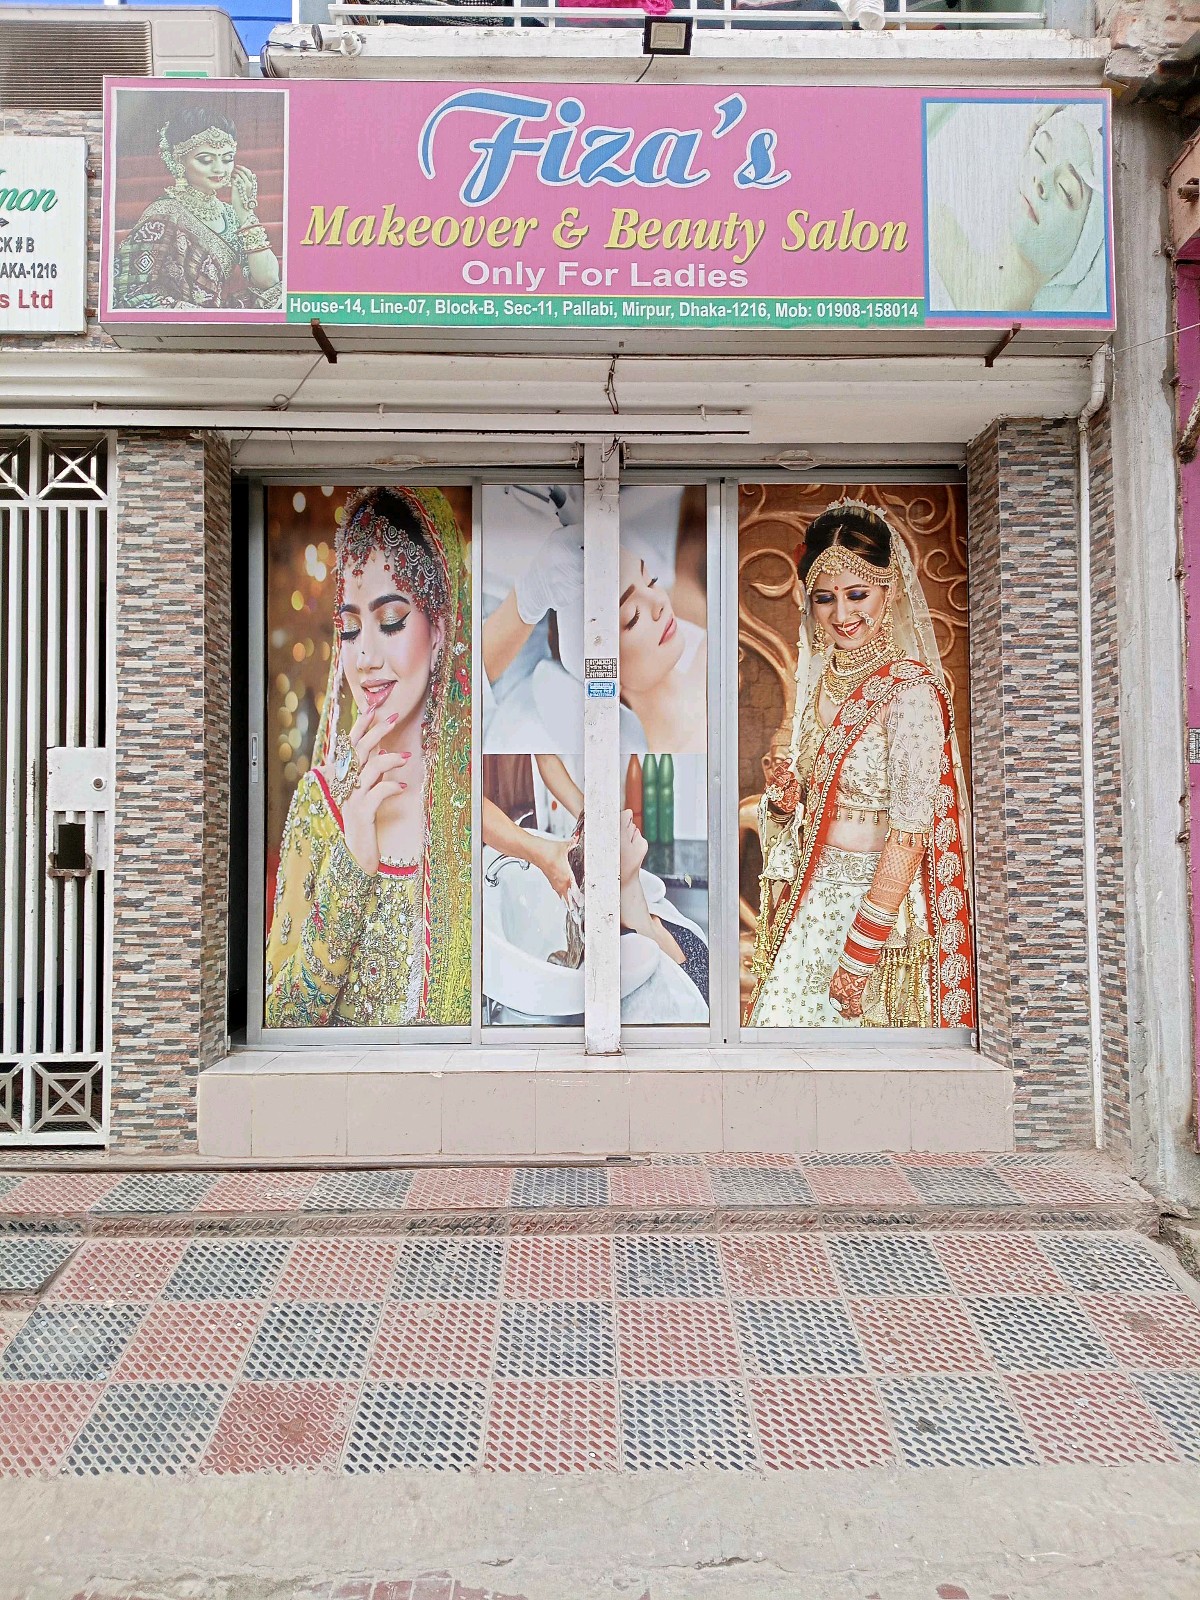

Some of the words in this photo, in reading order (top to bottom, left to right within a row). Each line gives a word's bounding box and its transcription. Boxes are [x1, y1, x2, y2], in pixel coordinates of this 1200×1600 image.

[418, 88, 792, 207] Fiza's
[0, 169, 58, 212] mon
[15, 236, 23, 253] #
[26, 236, 35, 253] B
[300, 203, 539, 248] Makeover
[552, 207, 590, 249] &
[603, 207, 767, 264] Beauty
[780, 208, 909, 251] Salon
[462, 260, 546, 292] Only
[558, 262, 618, 287] For
[630, 262, 749, 288] Ladies
[18, 288, 54, 309] Ltd
[289, 298, 366, 316] House-14,
[370, 298, 430, 317] Line-07,
[435, 299, 499, 318] Block-B,
[503, 300, 558, 318] Sec-11,
[562, 300, 618, 319] Pallabi,
[622, 302, 674, 319] Mirpur,
[679, 302, 771, 320] Dhaka-1216,
[775, 303, 813, 319] Mob:
[816, 302, 919, 319] 01908-158014
